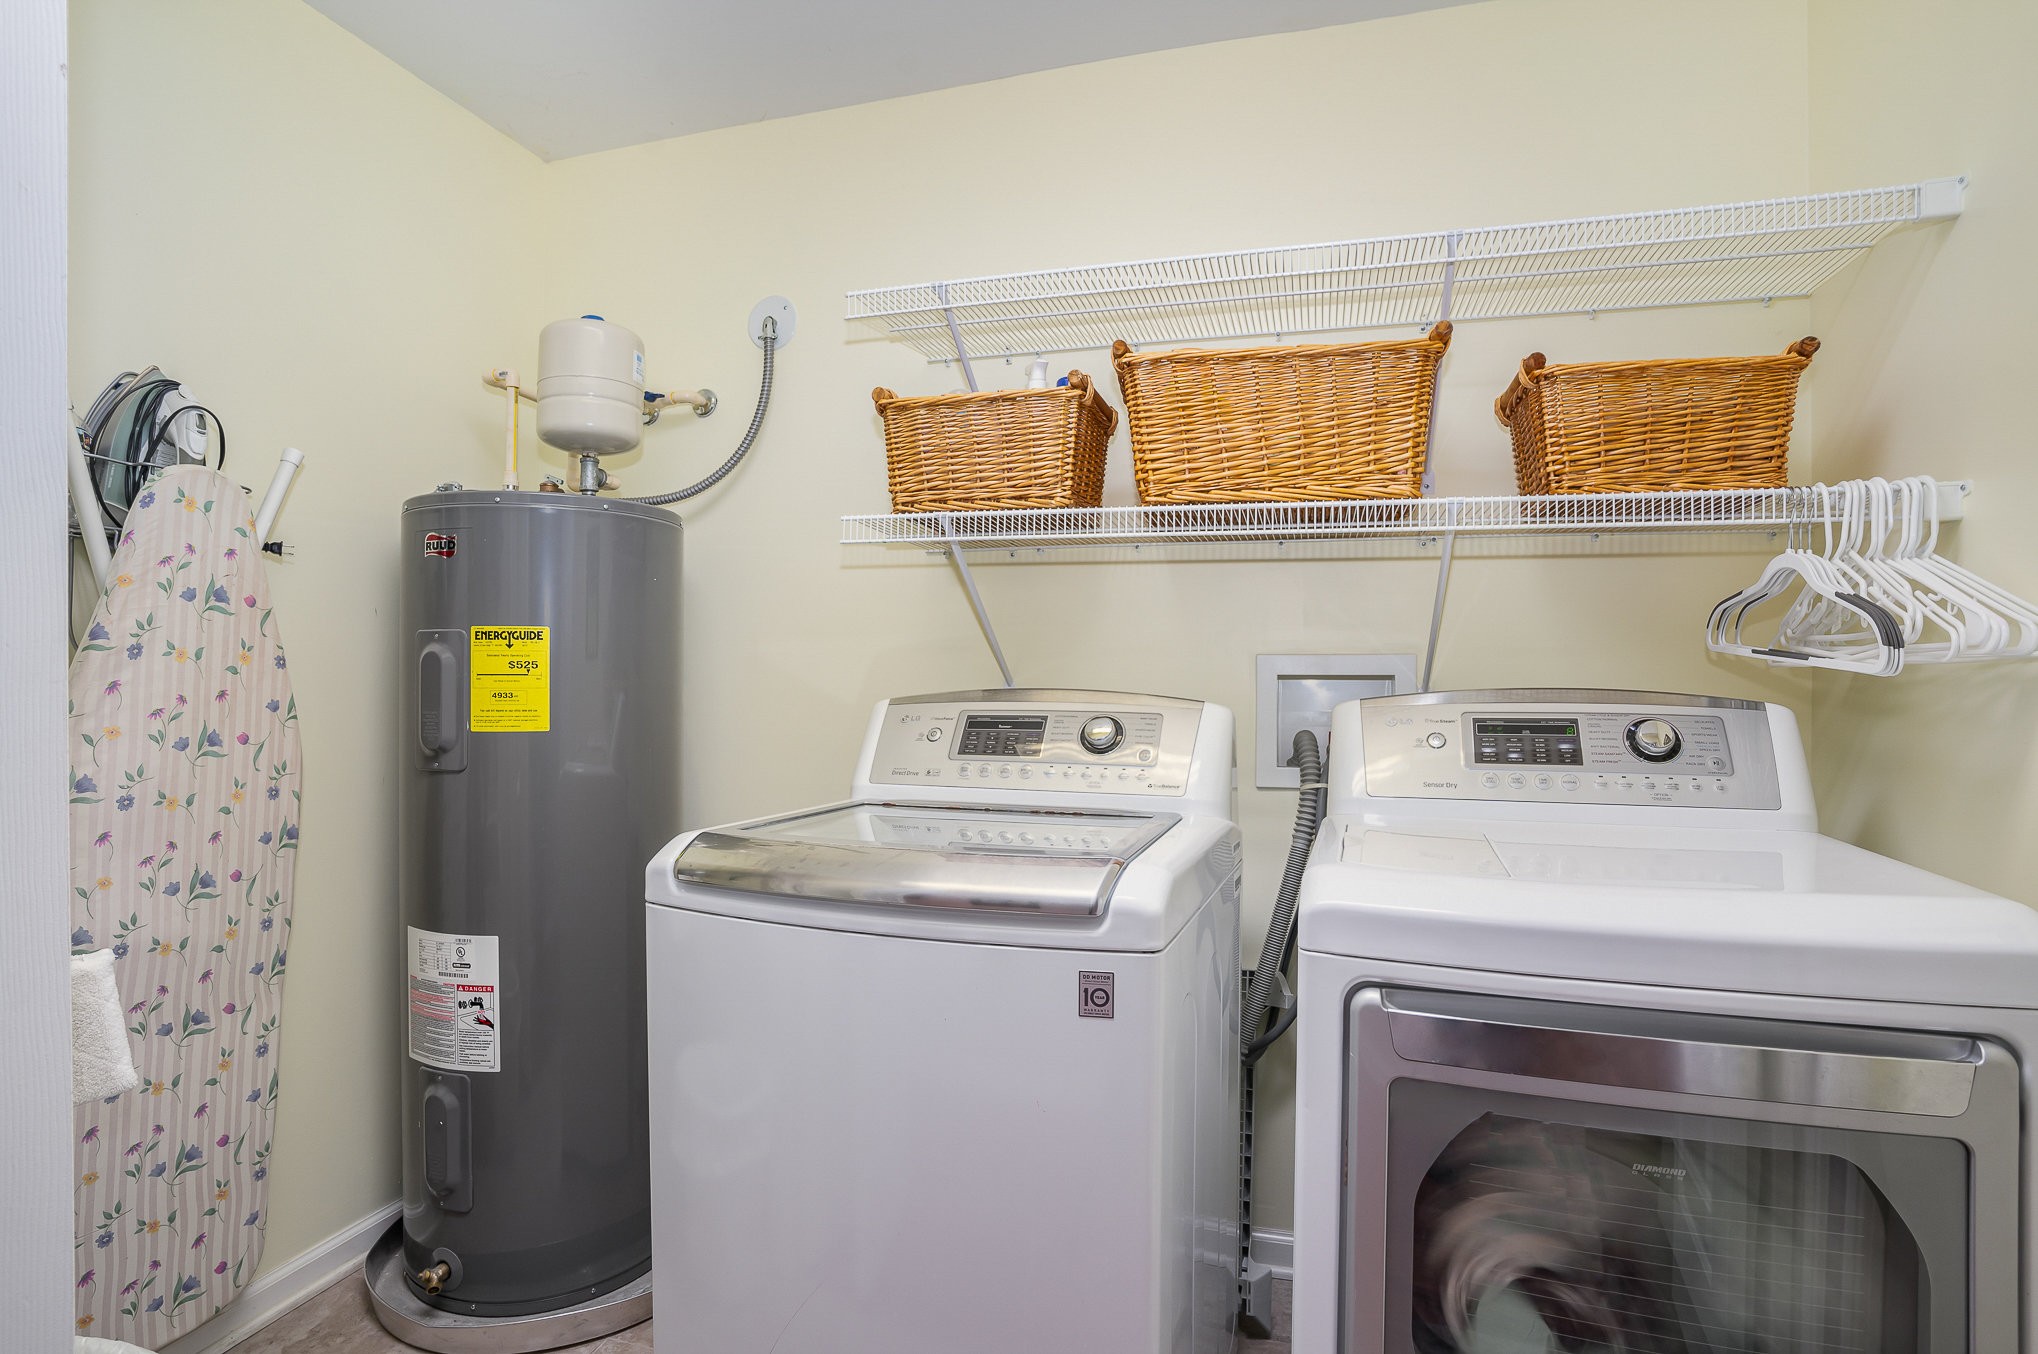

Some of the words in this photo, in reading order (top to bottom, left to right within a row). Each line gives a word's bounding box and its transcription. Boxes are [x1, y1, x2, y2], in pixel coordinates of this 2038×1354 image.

[426, 540, 455, 551] RUUD
[474, 630, 544, 641] ENERGYGUIDE
[508, 660, 539, 669] $525
[1083, 987, 1110, 1008] 10
[1632, 1163, 1687, 1177] DIAMOND
